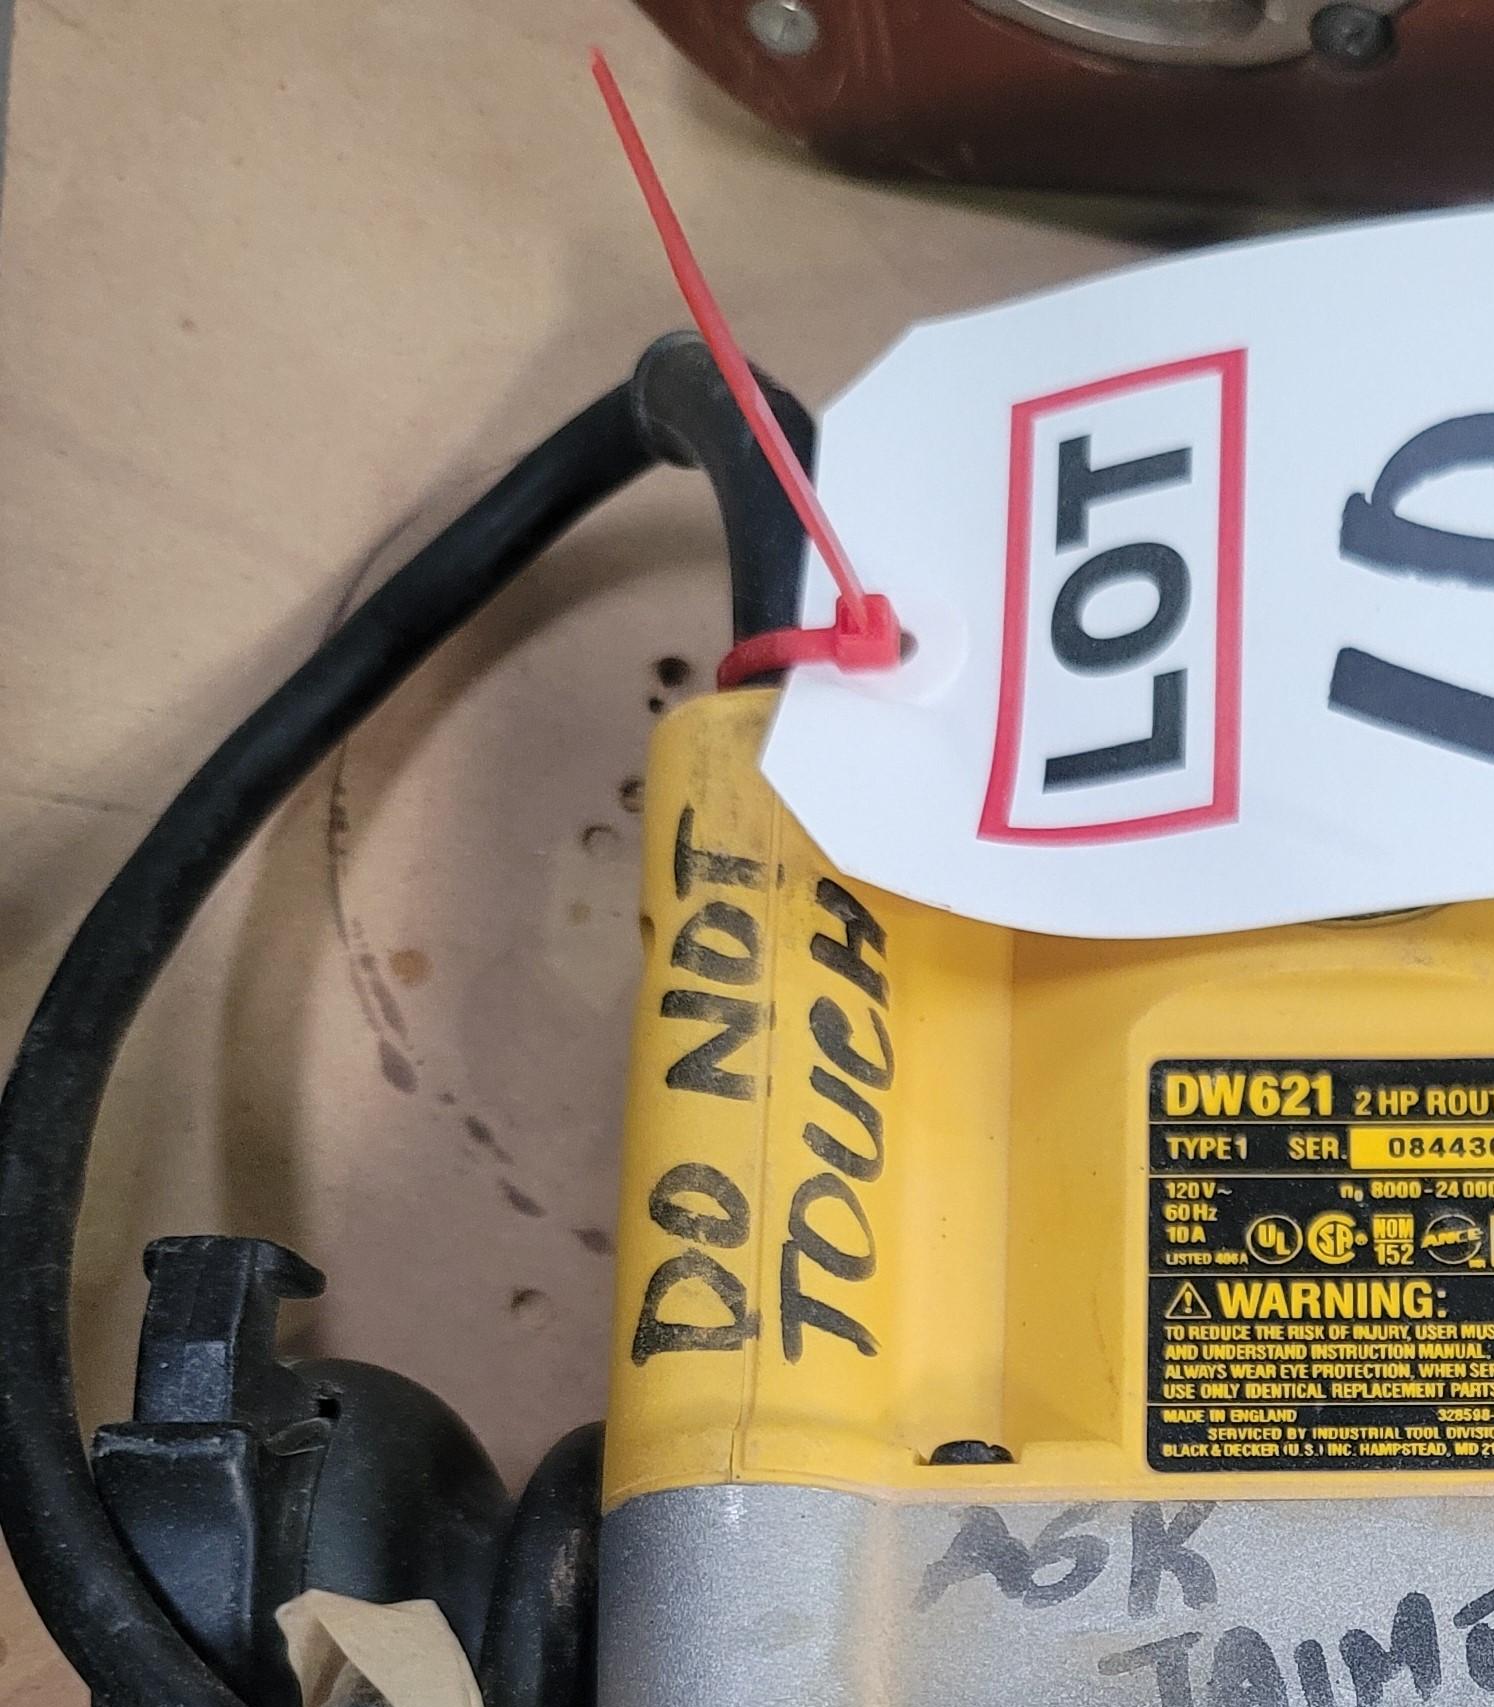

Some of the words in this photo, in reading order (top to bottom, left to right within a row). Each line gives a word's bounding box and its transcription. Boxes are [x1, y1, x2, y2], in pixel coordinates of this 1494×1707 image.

[1043, 434, 1193, 794] LOT
[660, 800, 785, 1102] NOT
[1163, 1073, 1334, 1118] DW621
[1354, 1091, 1373, 1117] 2
[1378, 1090, 1420, 1117] HP
[780, 876, 896, 1366] TOUCH
[1288, 1136, 1348, 1161] SER.
[1372, 1217, 1415, 1240] NOM
[631, 1161, 763, 1367] DO
[1165, 1251, 1214, 1266] LISTED
[1374, 1243, 1415, 1266] 152
[1216, 1281, 1448, 1320] WARNING:
[1164, 1324, 1186, 1342] TO
[1188, 1324, 1252, 1342] REDUCE
[1254, 1324, 1286, 1341] THE
[1287, 1324, 1326, 1341] RISK
[1328, 1324, 1351, 1341] OF
[1352, 1323, 1412, 1341] INJURY,
[1414, 1323, 1458, 1341] USER
[1164, 1344, 1199, 1361] AND
[1202, 1344, 1308, 1361] UNDERSTAND
[1310, 1343, 1416, 1360] INSTRUCTION
[1418, 1343, 1492, 1360] MANUAL.
[1164, 1363, 1228, 1380] ALWAYS
[1230, 1363, 1277, 1380] WEAR
[1280, 1362, 1309, 1380] EYE
[1417, 1362, 1467, 1379] WHEN
[1163, 1383, 1196, 1400] USE
[1200, 1383, 1241, 1400] ONLY
[1245, 1383, 1327, 1400] IDENTICAL
[1331, 1382, 1446, 1399] REPLACEMENT
[1162, 1409, 1205, 1424] MADE
[1209, 1409, 1226, 1424] IN
[1229, 1408, 1298, 1423] ENGLAND
[1206, 1427, 1283, 1442] SERVICED
[1286, 1427, 1308, 1441] BY
[1311, 1427, 1402, 1441] INDUSTRIAL
[1404, 1426, 1442, 1441] TOOL
[1162, 1443, 1209, 1458] BLACK
[1223, 1443, 1280, 1458] DECKER
[1359, 1442, 1452, 1457] HAMPSTEAD,
[1455, 1441, 1480, 1456] MD
